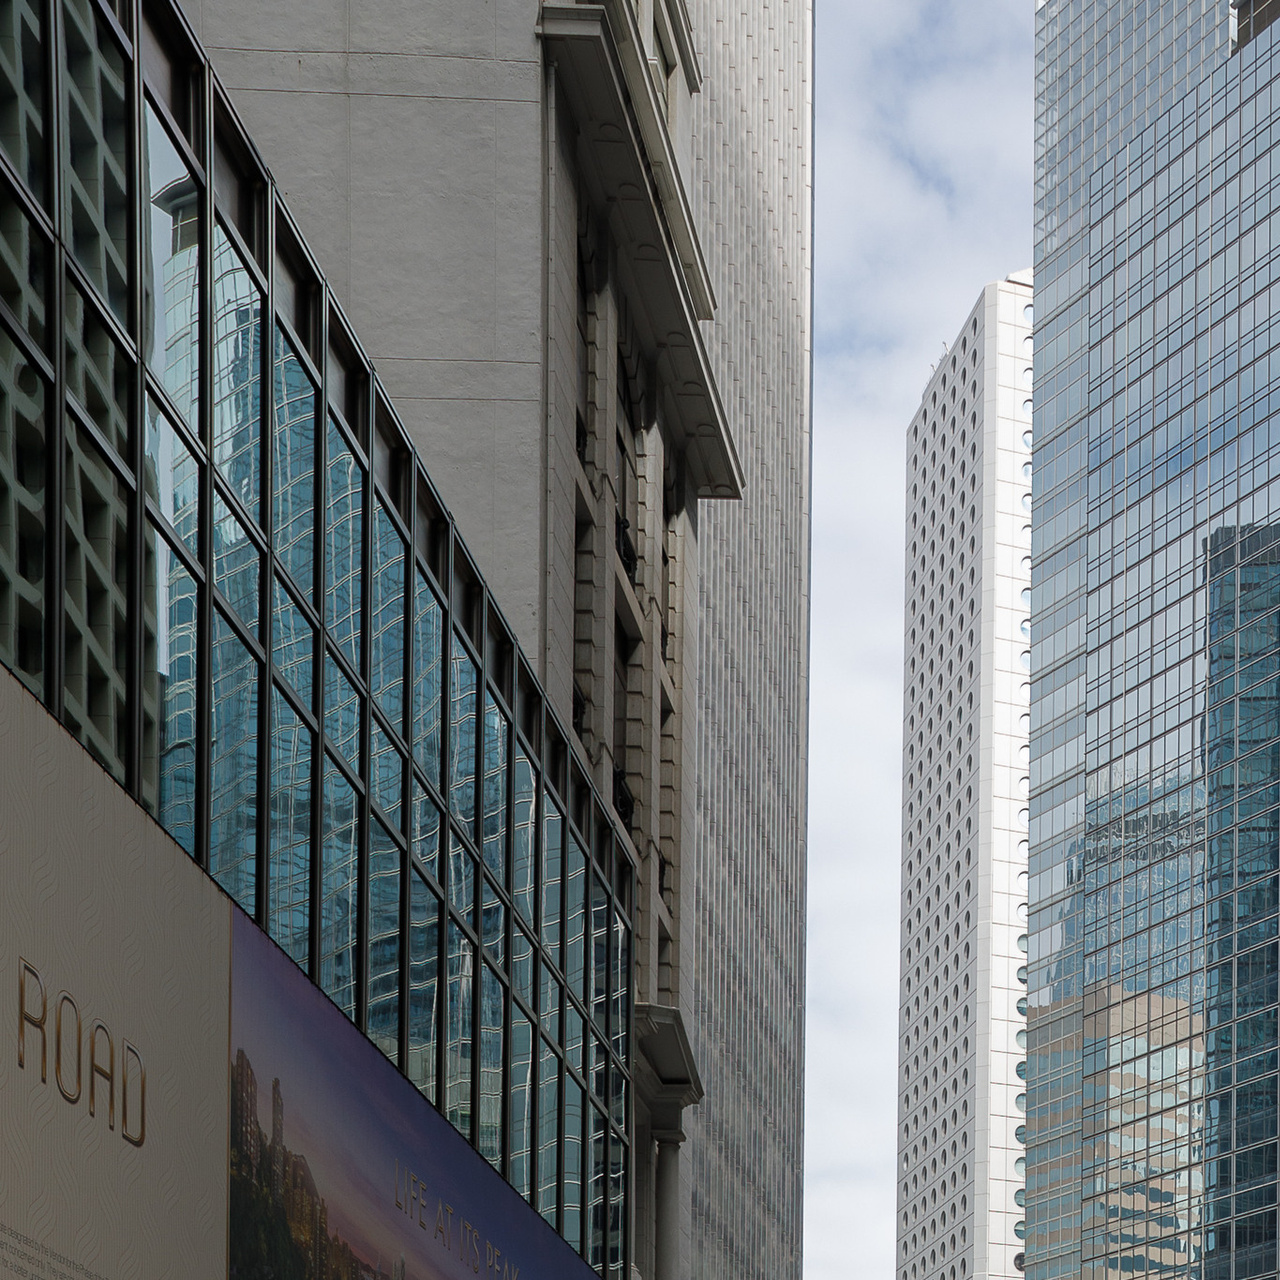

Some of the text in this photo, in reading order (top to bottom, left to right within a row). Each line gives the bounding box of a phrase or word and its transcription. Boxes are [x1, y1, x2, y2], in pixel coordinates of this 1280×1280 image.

[18, 956, 147, 1148] ROAD
[395, 1158, 427, 1230] LIFE
[434, 1197, 454, 1251] AT
[460, 1217, 480, 1274] ITS
